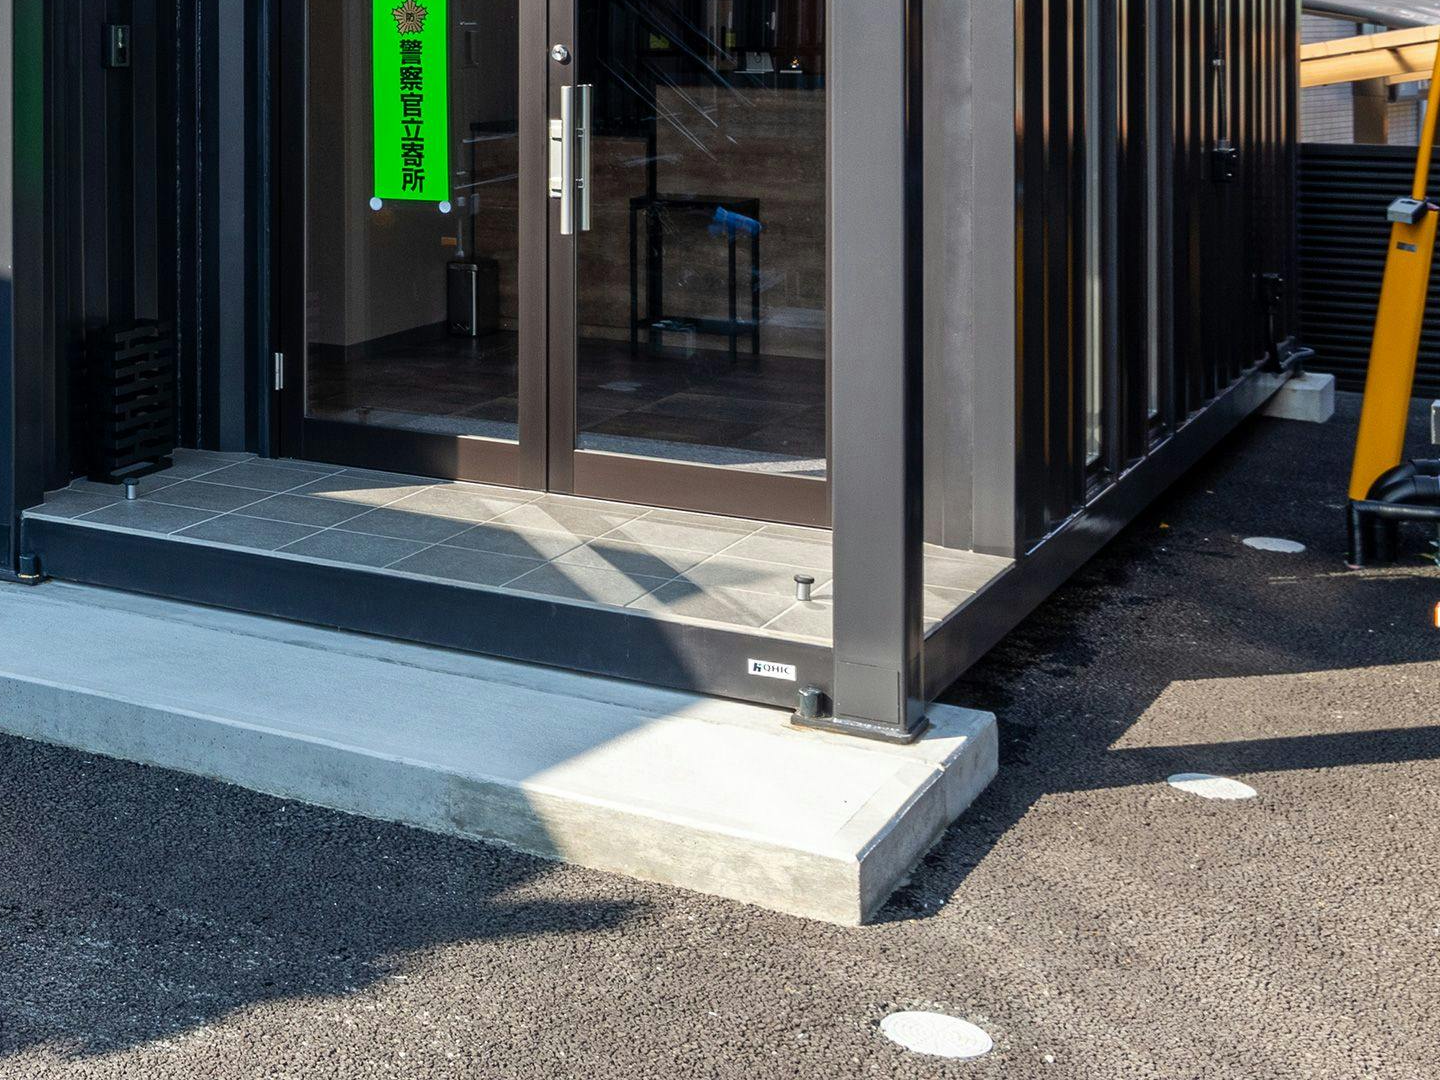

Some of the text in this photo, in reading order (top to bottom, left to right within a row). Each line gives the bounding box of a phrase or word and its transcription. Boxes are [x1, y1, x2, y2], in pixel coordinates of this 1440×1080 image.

[399, 39, 426, 194] 警察官立寄所
